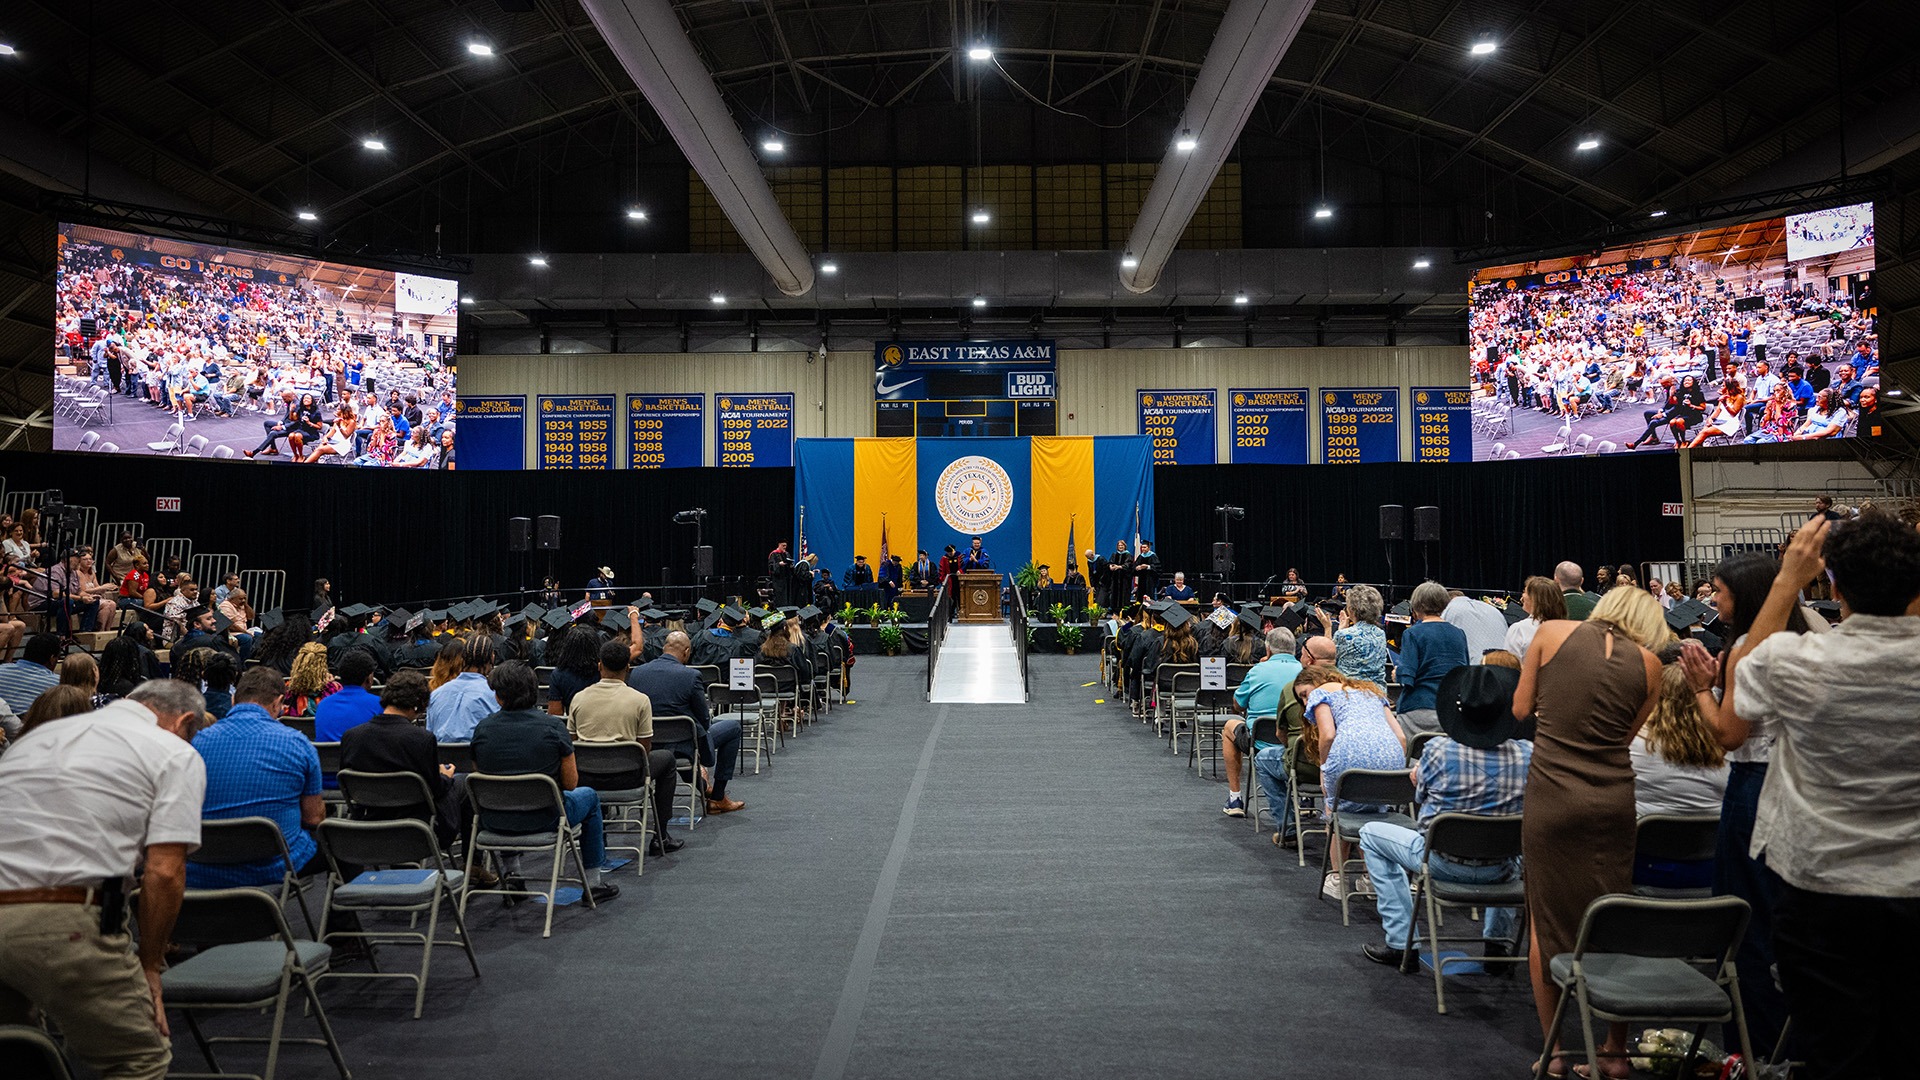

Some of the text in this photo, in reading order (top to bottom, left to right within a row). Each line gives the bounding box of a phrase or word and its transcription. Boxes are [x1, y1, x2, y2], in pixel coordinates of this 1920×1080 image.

[160, 256, 190, 270] GO
[1544, 272, 1570, 284] GO
[909, 346, 1050, 360] EAST TEXAS A&M
[1016, 375, 1046, 384] BUD
[1011, 385, 1051, 395] LIGHT
[1145, 416, 1177, 425] 2007
[1237, 415, 1269, 424] 2007
[1328, 414, 1393, 423] 1998 2022
[1420, 414, 1448, 422] 1942
[545, 421, 607, 430] 1934 1955
[633, 420, 663, 429] 1990
[723, 420, 788, 428] 1996 2022
[1145, 427, 1174, 436] 2019
[1237, 426, 1269, 435] 2020
[1328, 426, 1357, 434] 1999
[1420, 425, 1450, 434] 1964
[545, 432, 607, 441] 1939 1957
[633, 431, 663, 440] 1996
[723, 431, 751, 440] 1997
[1153, 438, 1177, 447] 020
[1237, 438, 1266, 447] 2021
[1328, 437, 1357, 446] 2001
[1420, 436, 1450, 445] 1965
[545, 444, 607, 452] 1940 1958
[633, 443, 663, 451] 1998
[723, 442, 752, 451] 1998
[1153, 450, 1174, 458] 021
[1328, 448, 1360, 457] 2002
[1420, 448, 1450, 456] 1998
[545, 454, 607, 463] 1942 1964
[633, 454, 665, 463] 2005
[722, 454, 754, 462] 2005
[157, 499, 180, 509] EXIT
[956, 504, 992, 518] UNIVERSITY
[1663, 504, 1683, 514] EXIT
